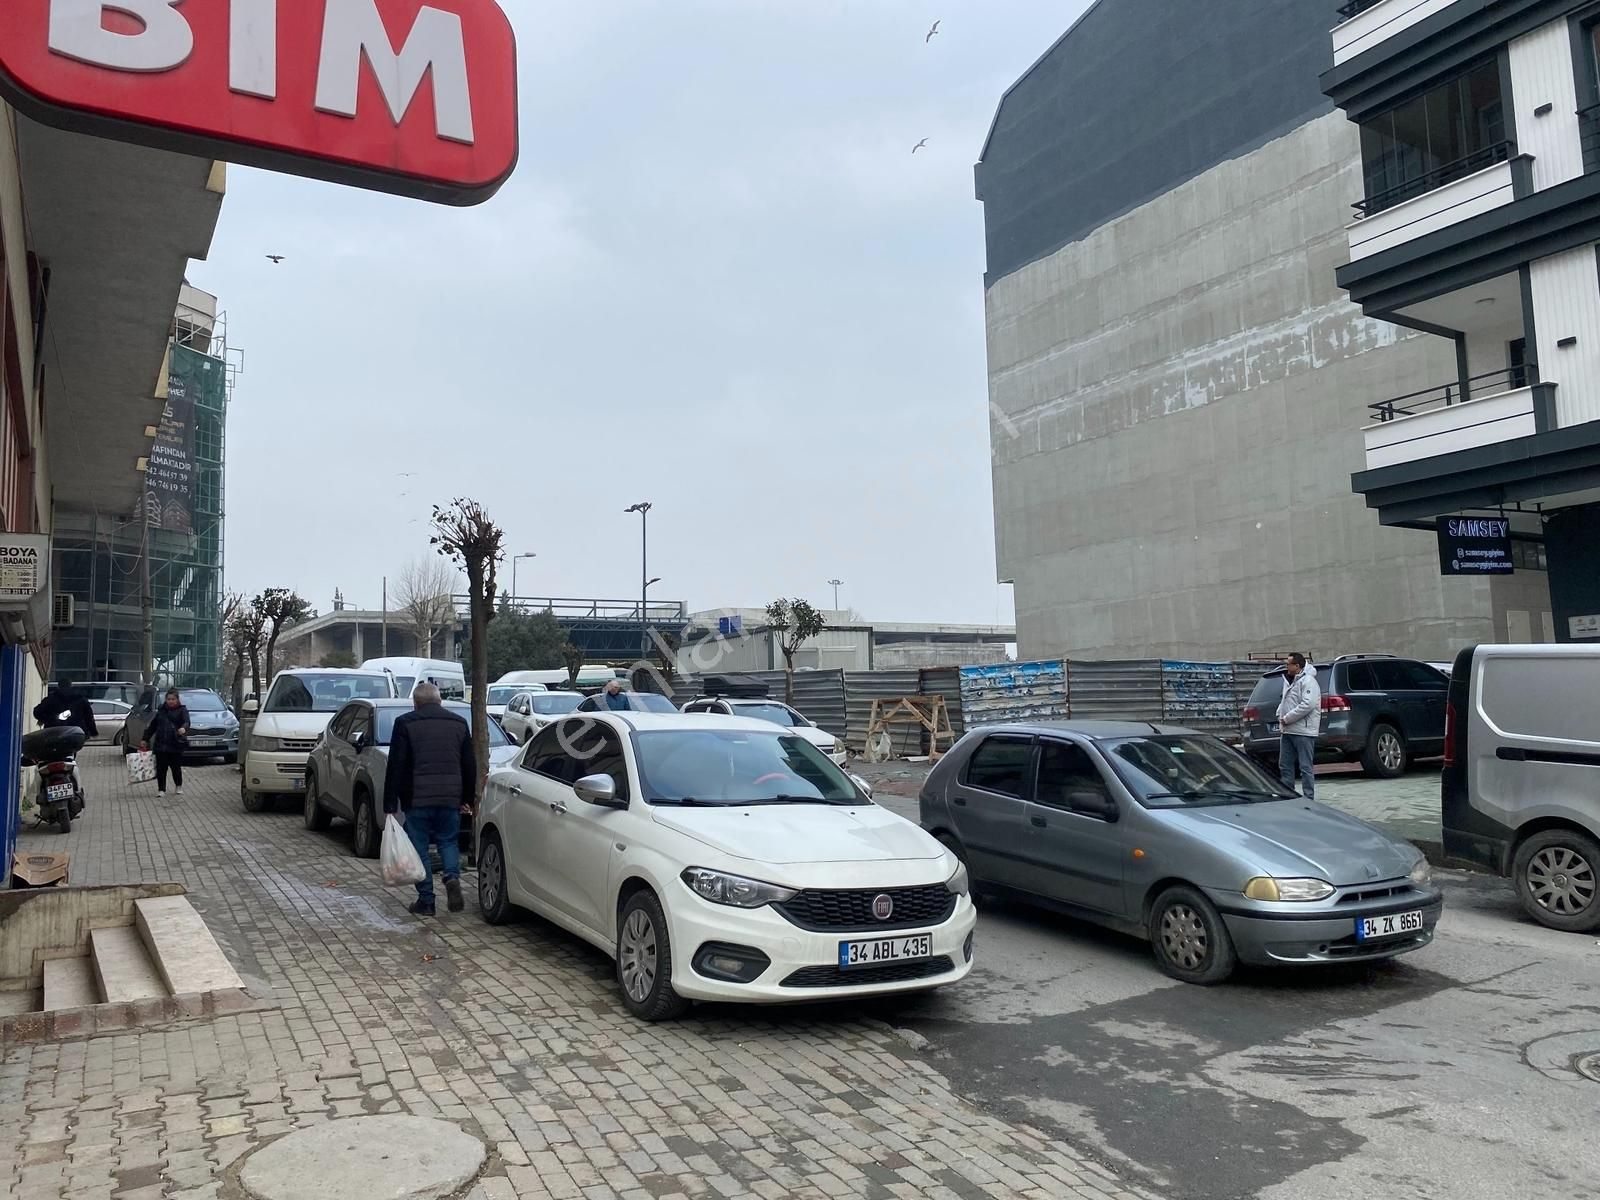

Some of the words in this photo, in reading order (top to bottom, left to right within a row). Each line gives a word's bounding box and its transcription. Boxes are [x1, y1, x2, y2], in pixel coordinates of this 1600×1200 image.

[1449, 520, 1508, 538] SAMSEY
[0, 547, 38, 557] BOYA
[3, 557, 33, 565] BADANA
[877, 901, 889, 913] FIAT
[1364, 920, 1377, 936] 34
[1383, 917, 1395, 934] ZK
[1400, 912, 1421, 930] 8661
[850, 944, 868, 962] 34
[873, 941, 899, 960] ABL
[903, 938, 928, 956] 435
